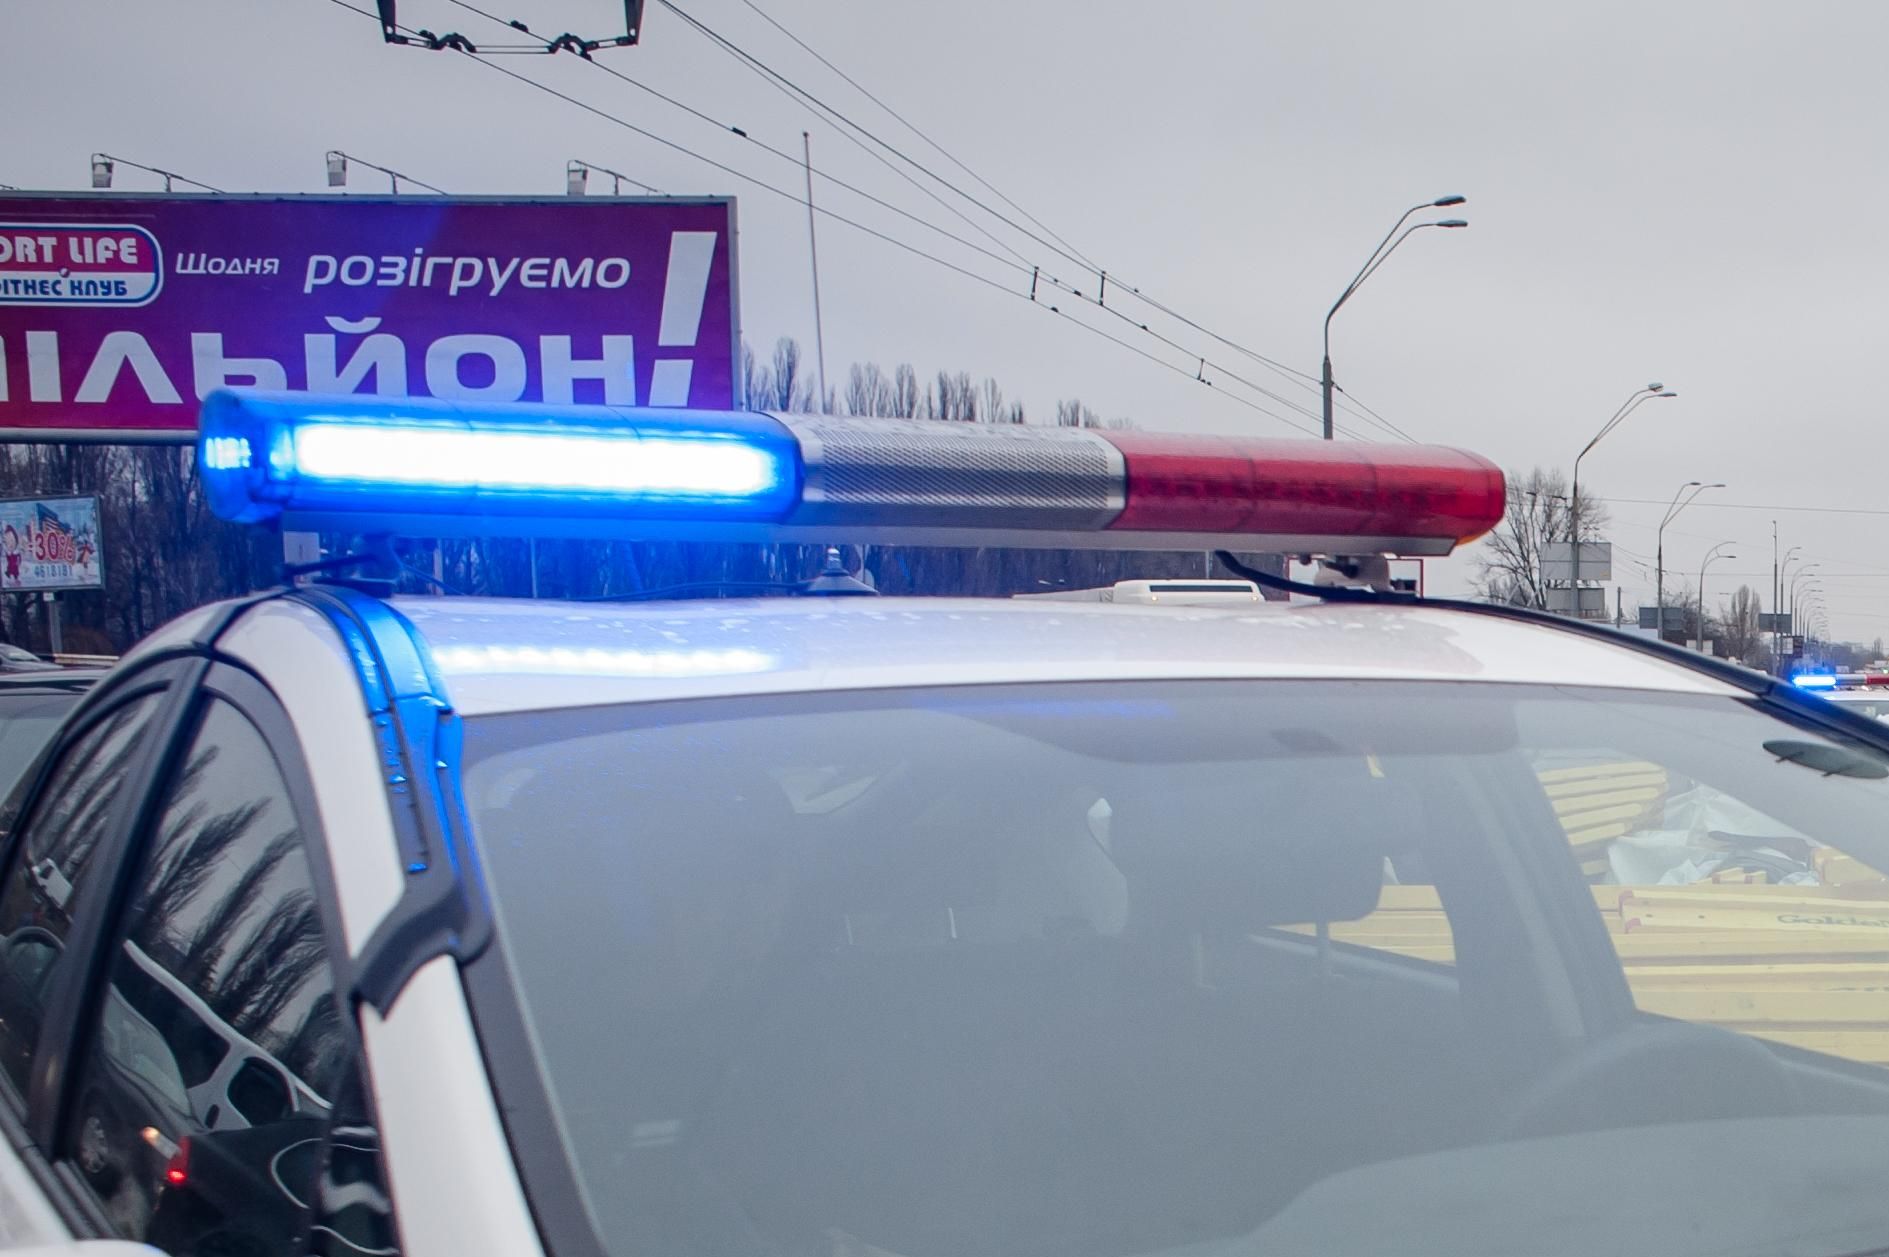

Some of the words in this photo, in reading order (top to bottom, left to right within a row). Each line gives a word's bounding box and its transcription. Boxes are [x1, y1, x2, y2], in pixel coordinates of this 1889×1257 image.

[69, 237, 138, 264] LIFE
[175, 252, 280, 275] Щодня
[303, 247, 631, 296] розігруємо
[0, 279, 64, 296] ІТНЕС
[70, 280, 128, 297] КЛУБ
